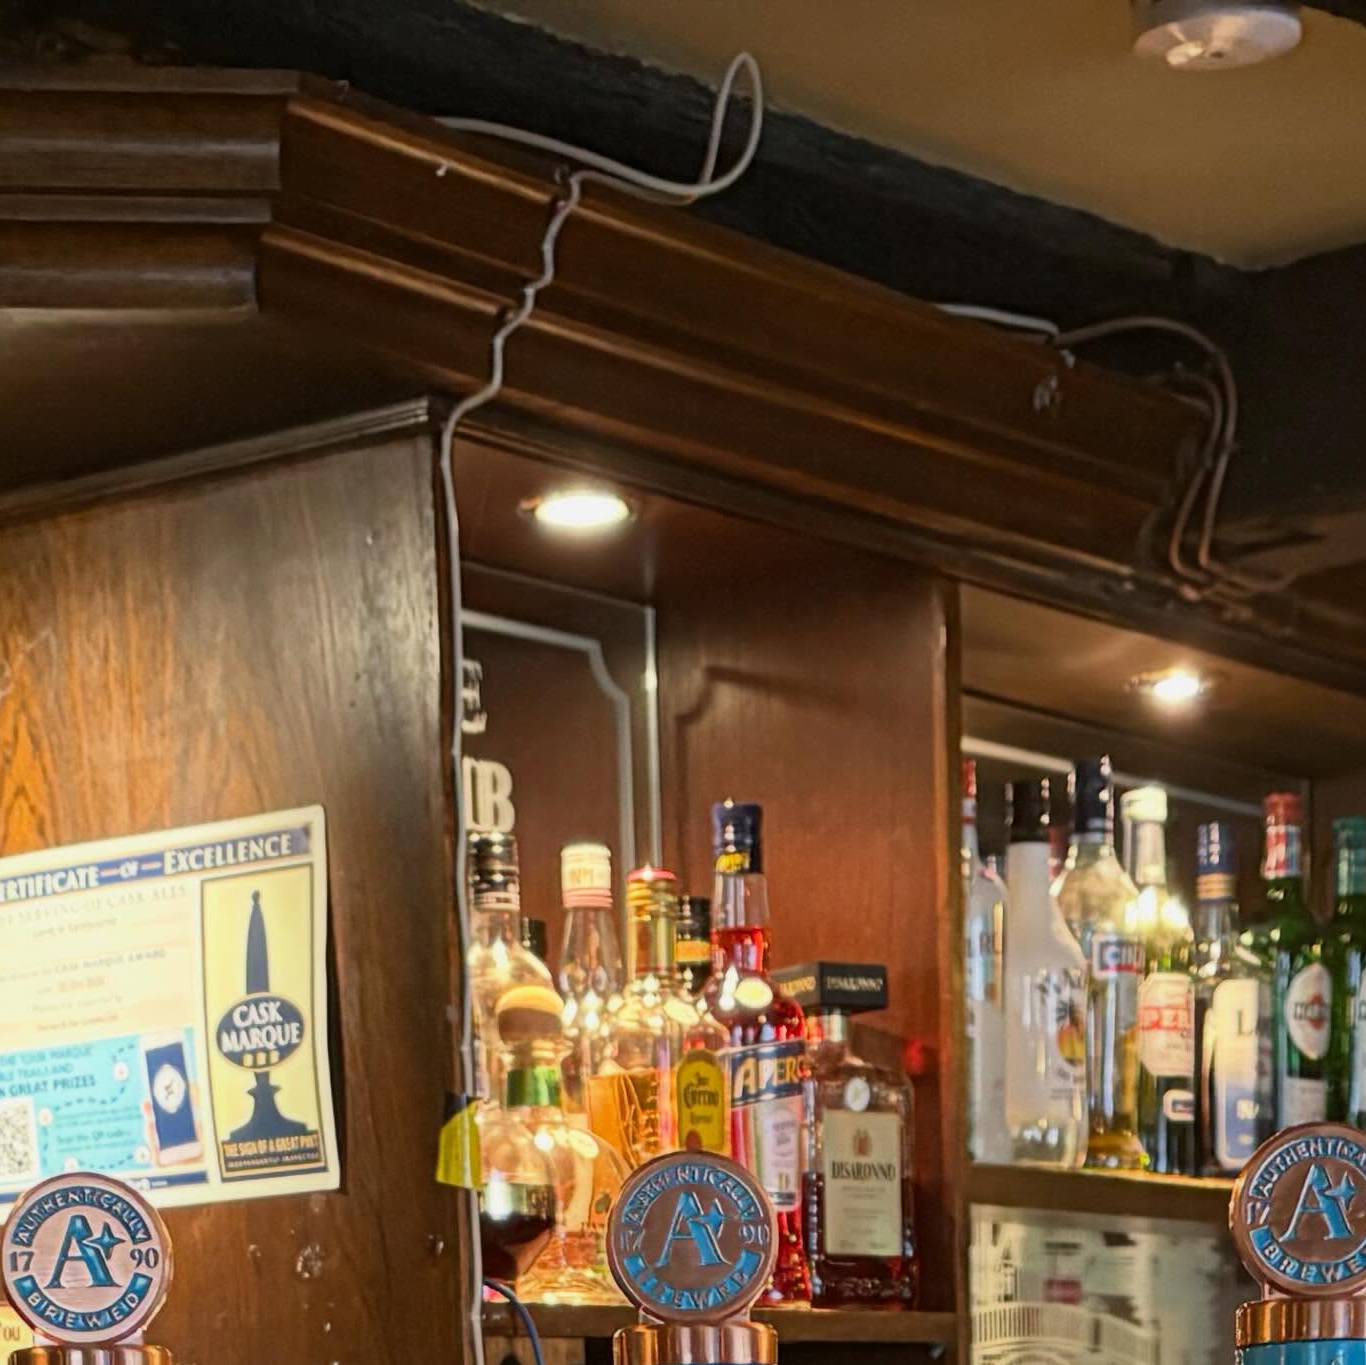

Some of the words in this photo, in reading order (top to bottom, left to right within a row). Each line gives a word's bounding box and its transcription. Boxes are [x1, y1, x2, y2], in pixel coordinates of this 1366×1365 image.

[163, 834, 292, 875] EXCELLENCE
[232, 1001, 283, 1028] CASK
[221, 1022, 301, 1052] MARQUE
[10, 1081, 48, 1096] GREAT
[53, 1075, 96, 1090] PRIZES
[831, 1159, 896, 1181] DISARONNO
[15, 1190, 151, 1246] AUTHENTICALLY
[10, 1251, 35, 1272] 17
[130, 1248, 159, 1269] 90
[27, 1292, 139, 1329] BREWED
